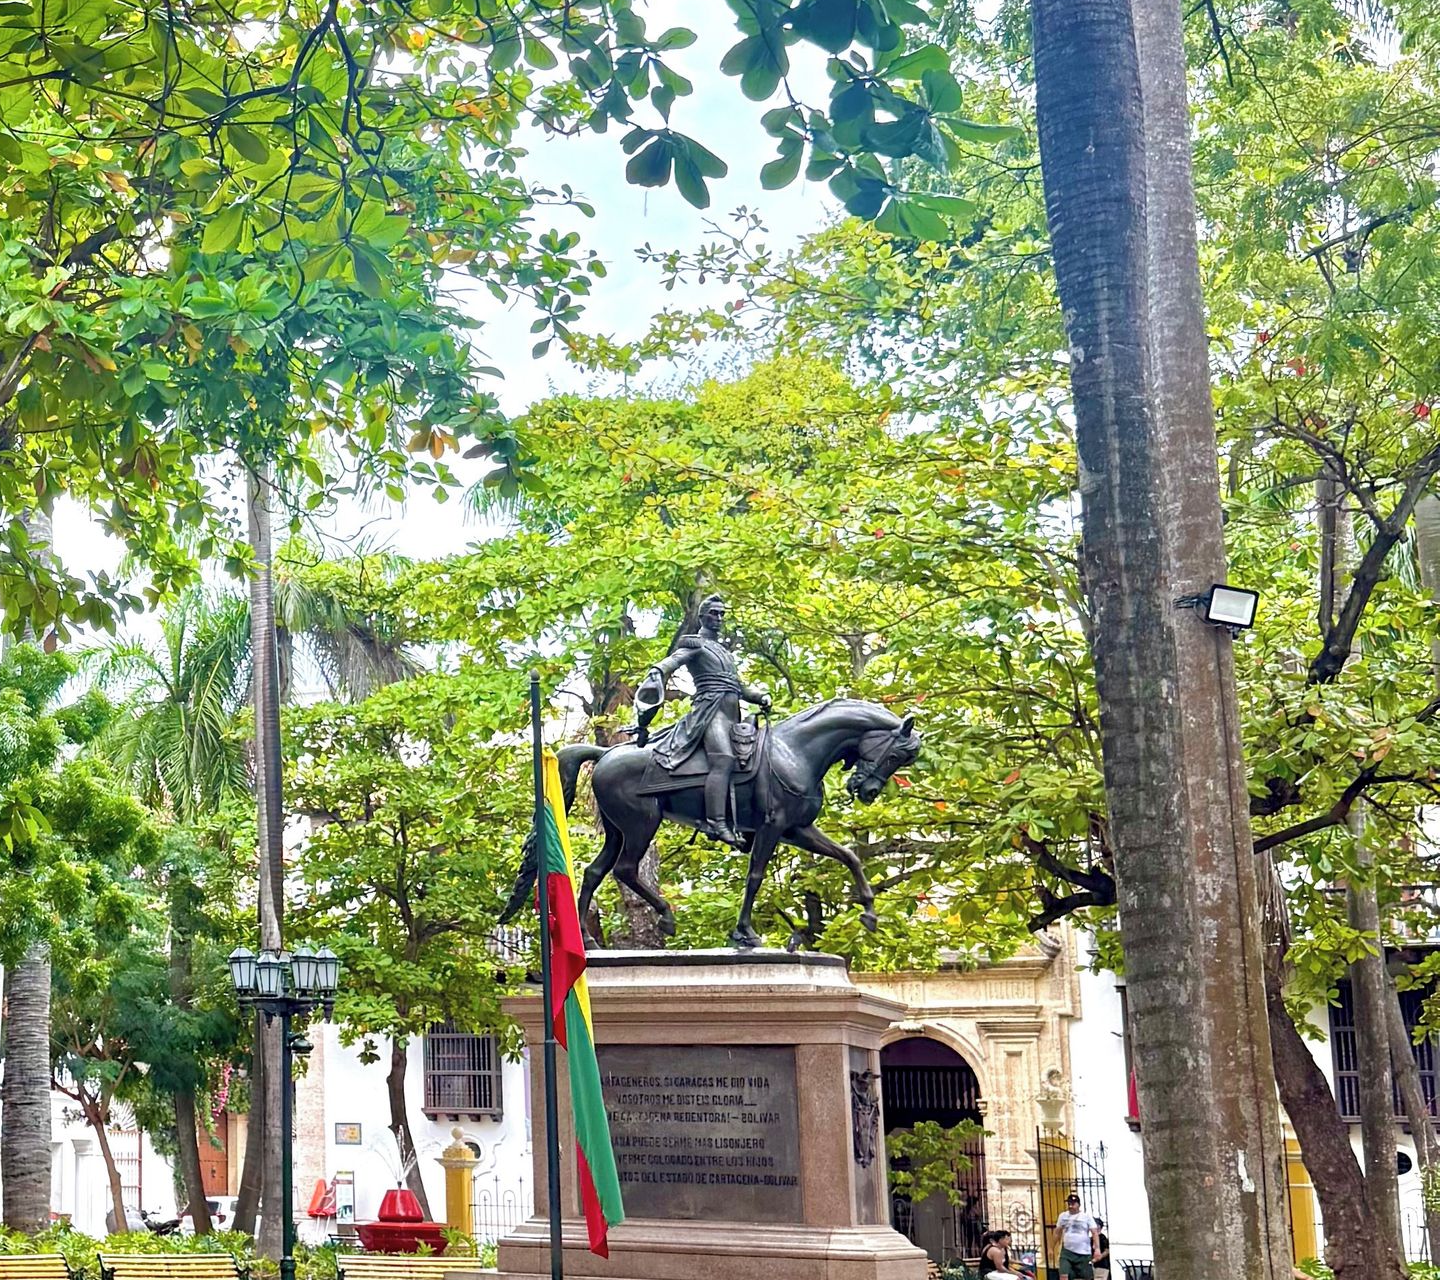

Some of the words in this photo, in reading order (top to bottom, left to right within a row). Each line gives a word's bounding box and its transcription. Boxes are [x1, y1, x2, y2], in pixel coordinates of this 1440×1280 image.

[674, 1076, 714, 1088] CARACAS
[716, 1077, 728, 1088] ME
[731, 1077, 745, 1088] DIO
[747, 1077, 770, 1089] VIDA
[617, 1094, 661, 1105] VOSOTROS
[662, 1094, 675, 1105] ME
[677, 1094, 710, 1106] DISTEIS
[741, 1113, 780, 1124] BOLIVAR
[611, 1136, 630, 1147] ADA
[632, 1136, 660, 1148] PUEDE
[715, 1138, 765, 1149] LISONJERO
[746, 1156, 774, 1167] HIJOS
[641, 1172, 658, 1183] DEL
[659, 1172, 693, 1184] ESTADO
[696, 1173, 707, 1184] DE
